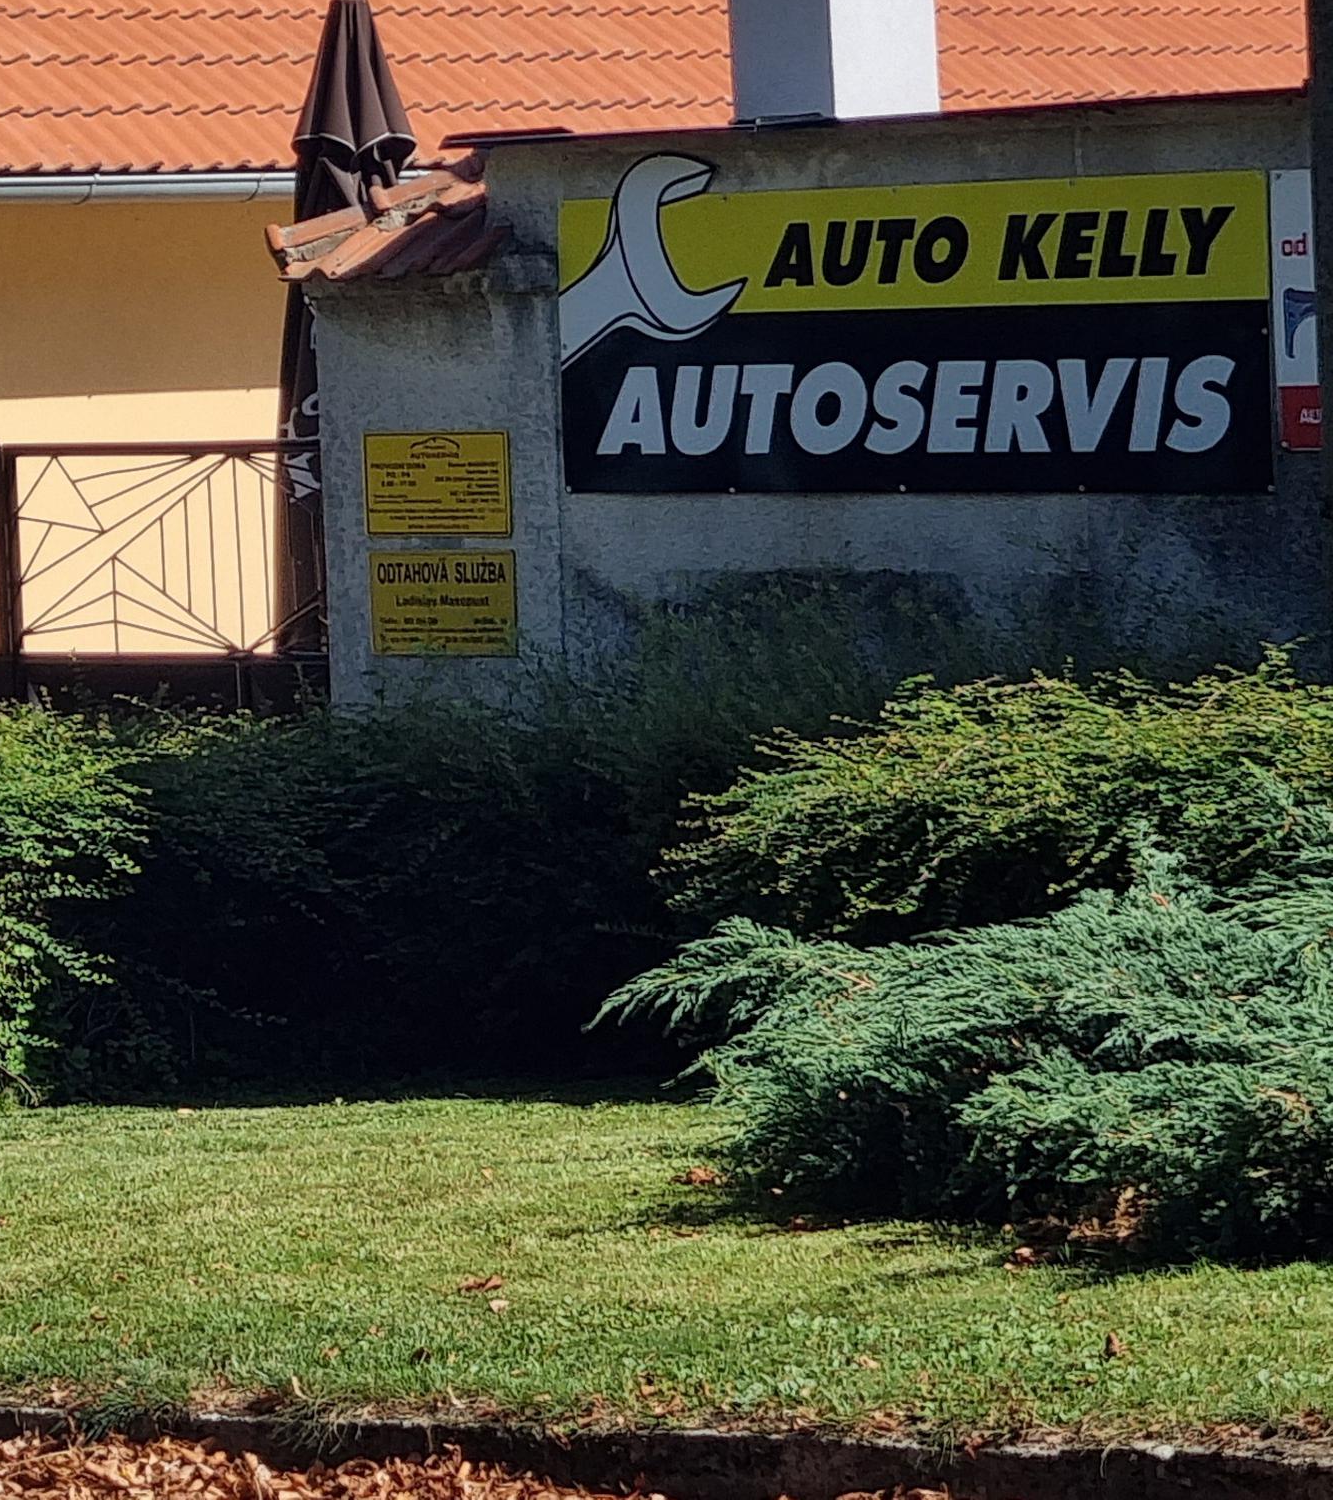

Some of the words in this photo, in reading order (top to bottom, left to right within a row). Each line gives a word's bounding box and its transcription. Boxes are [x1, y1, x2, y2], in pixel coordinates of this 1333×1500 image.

[763, 215, 969, 288] AUTO
[998, 205, 1235, 281] KELLY
[597, 354, 1236, 456] AUTOSERVIS
[377, 557, 449, 584] ODTAHOVÁ
[455, 556, 507, 584] SLUŽBA
